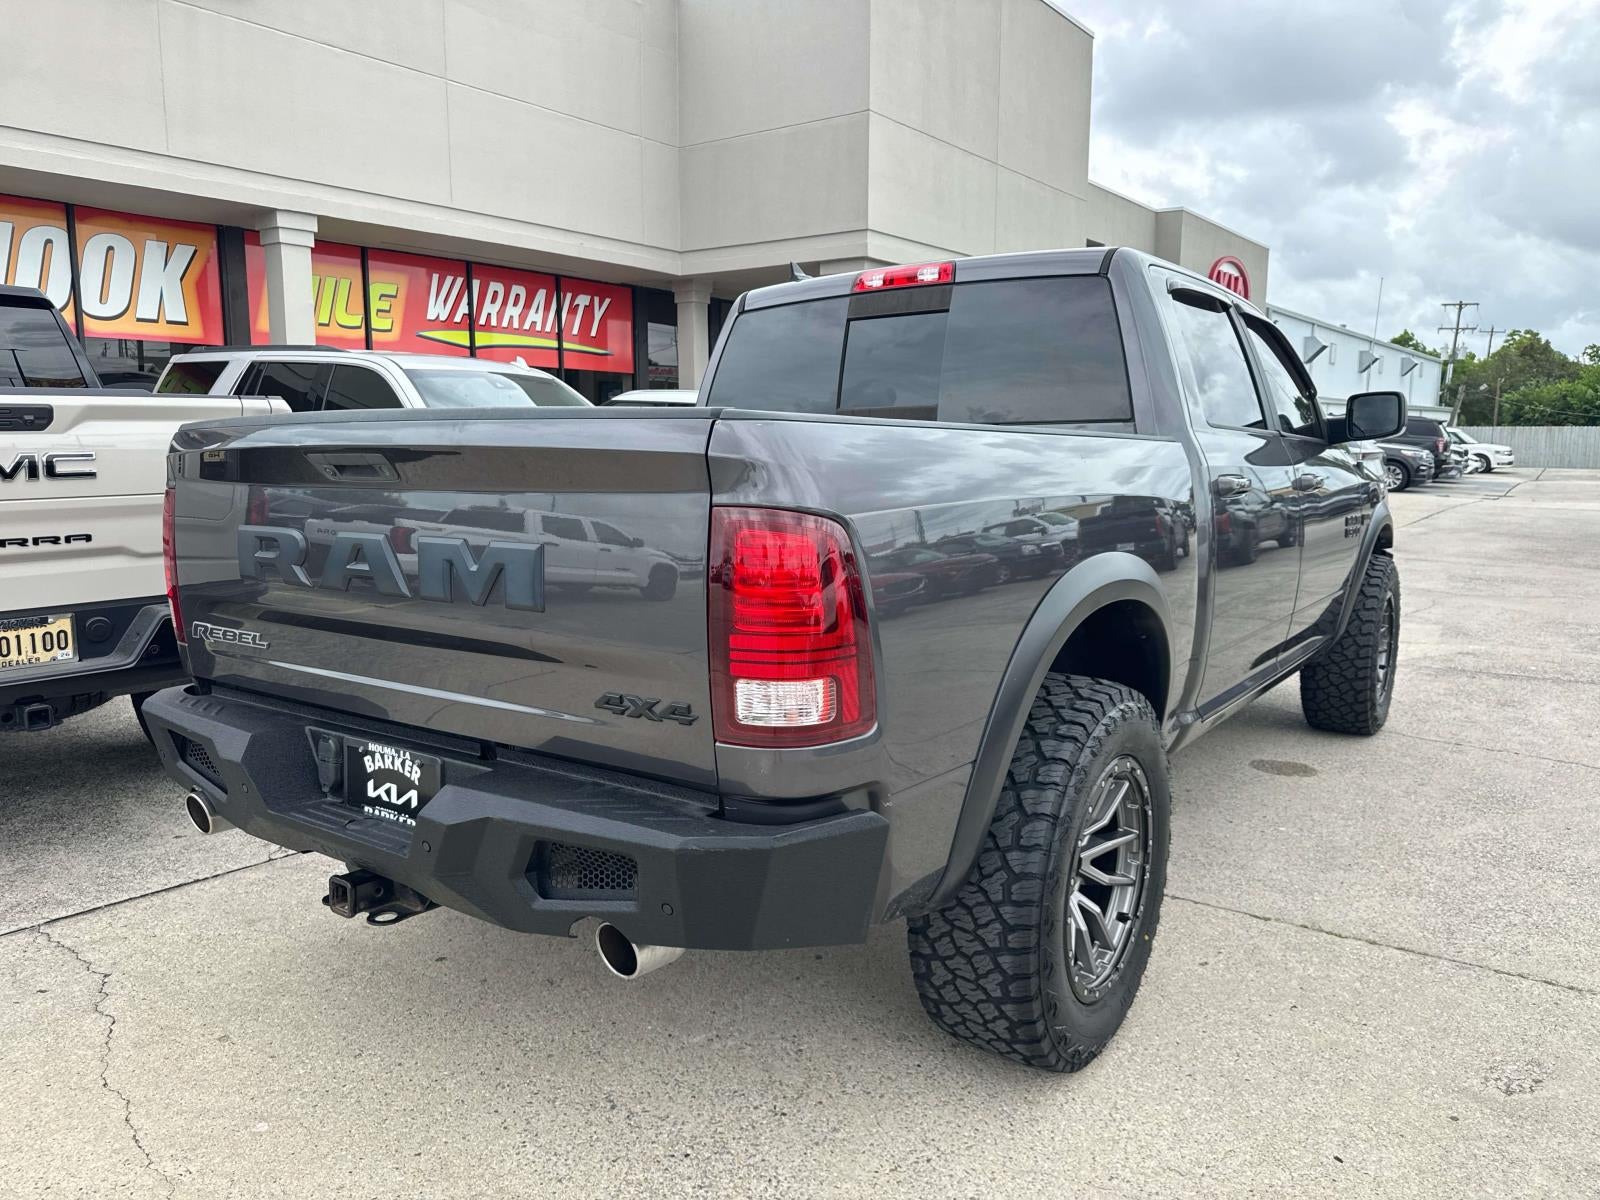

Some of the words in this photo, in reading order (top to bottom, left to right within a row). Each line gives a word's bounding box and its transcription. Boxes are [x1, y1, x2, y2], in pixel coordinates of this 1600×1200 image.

[426, 272, 612, 338] WARRANTY
[238, 524, 545, 613] RAM
[0, 629, 69, 658] 01100
[192, 621, 270, 649] REBEL
[2, 656, 41, 668] DEALER
[368, 742, 399, 758] HOUMA,
[400, 750, 411, 760] LA
[363, 752, 421, 786] BARKER
